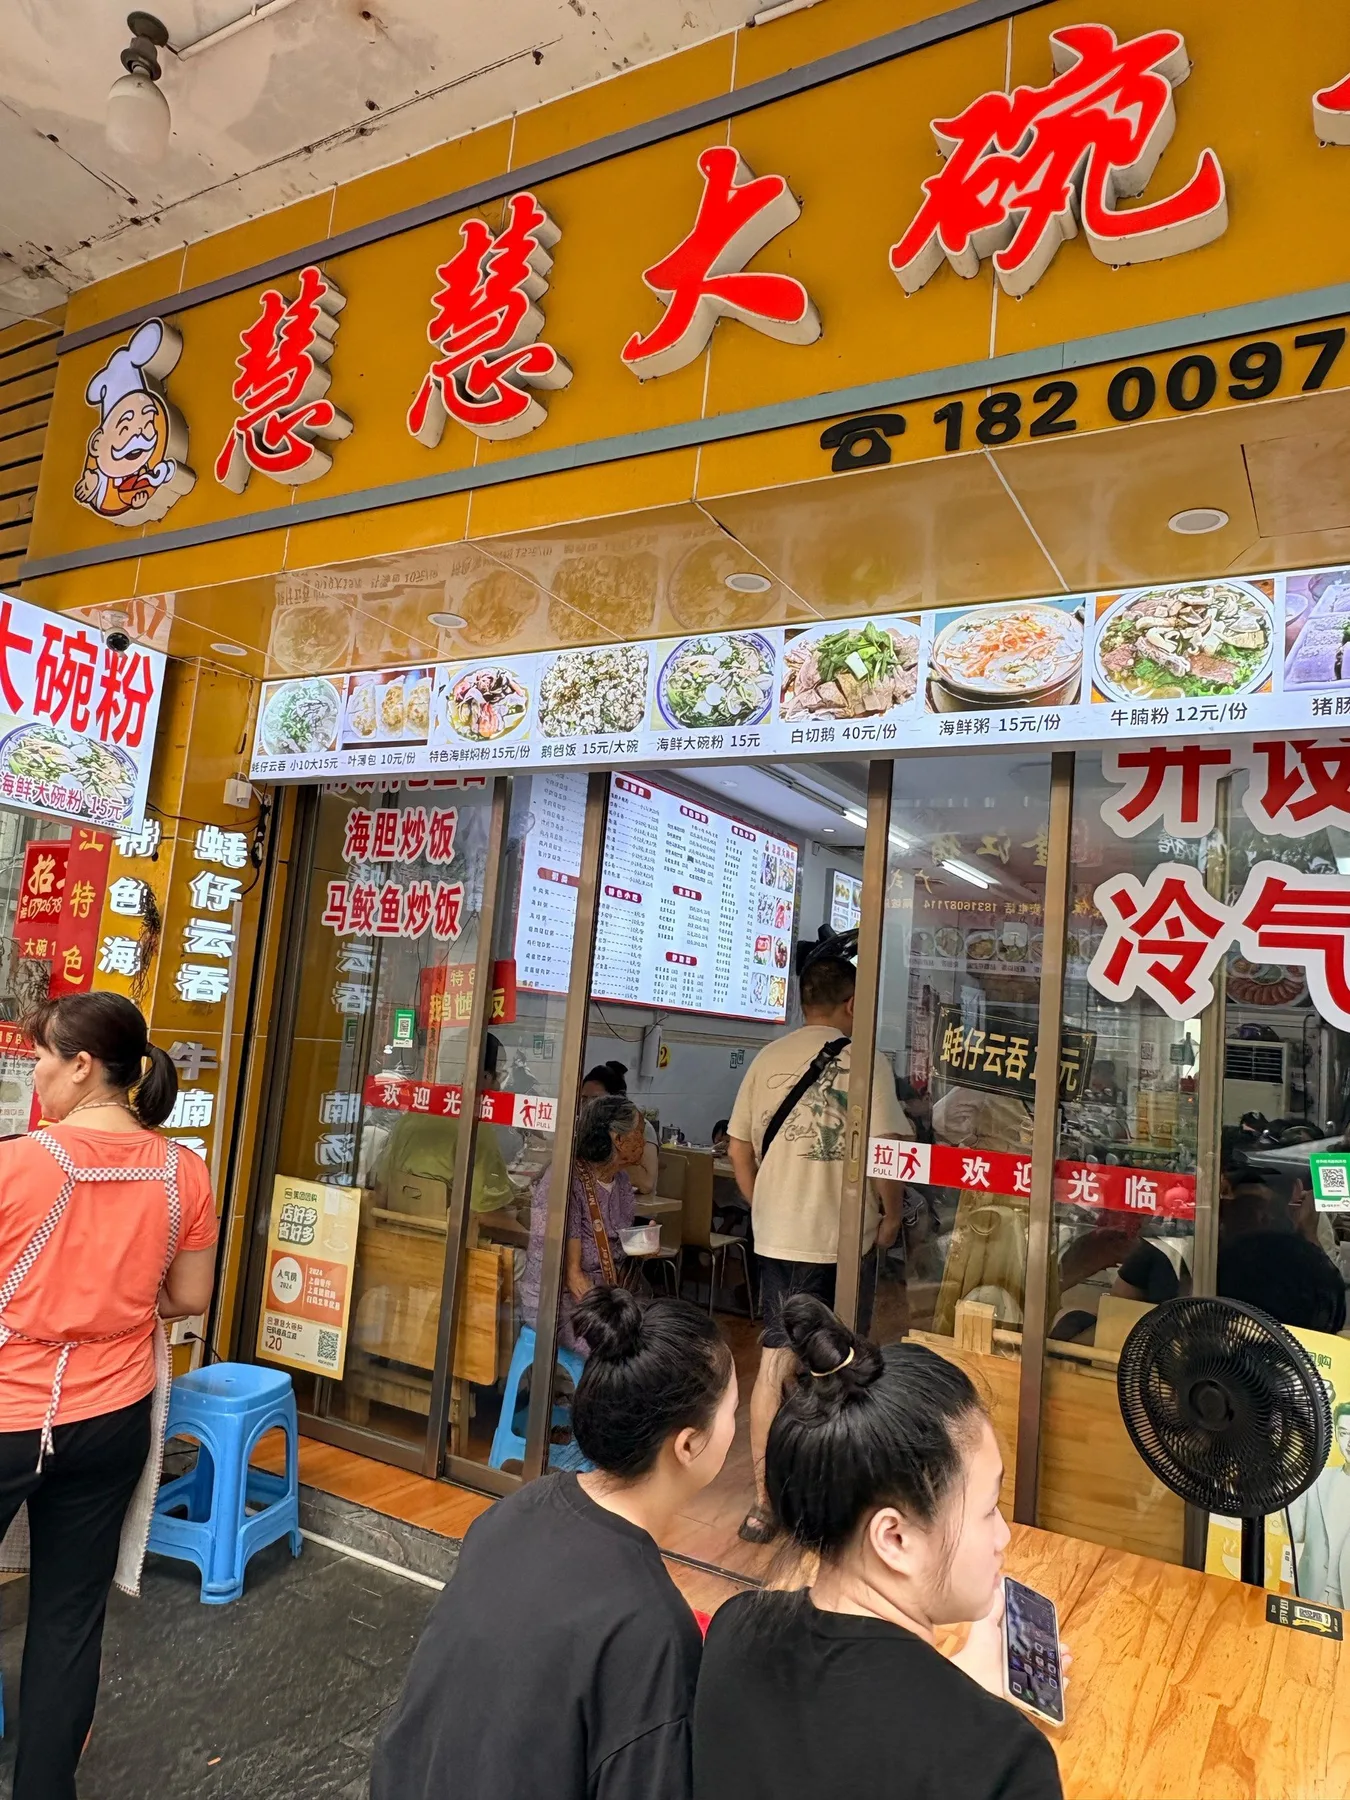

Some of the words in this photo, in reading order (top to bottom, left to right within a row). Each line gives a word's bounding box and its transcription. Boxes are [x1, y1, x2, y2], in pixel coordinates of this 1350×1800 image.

[215, 23, 1350, 483] 慧慧大碗
[933, 381, 1077, 451] 182
[1107, 328, 1346, 421] 0097
[0, 601, 154, 748] 大碗粉
[938, 718, 990, 736] 海鲜粥
[998, 714, 1061, 734] 15元/份
[1110, 707, 1168, 727] 牛腩粉
[1175, 702, 1248, 723] 12元/份
[656, 735, 724, 751] 海鲜大碗粉
[731, 733, 761, 748] 15元
[791, 727, 835, 743] 白切鹅
[842, 723, 897, 742] 40元/份
[429, 748, 490, 763] 特色海鲜焖粉
[492, 745, 530, 759] 15元/份
[582, 739, 639, 755] 15元/大碗
[251, 760, 286, 773] 蚝仔云吞
[290, 757, 339, 771] 小10大15元
[381, 752, 416, 766] 10元/份
[0, 771, 84, 814] 海鲜大碗粉
[90, 795, 124, 822] 15元
[345, 809, 457, 861] 海胆炒饭
[175, 823, 248, 1004] 蚝仔云吞
[324, 884, 463, 937] 马鲛鱼炒饭
[1103, 876, 1350, 1016] 冷气
[538, 1102, 553, 1121] 拉
[536, 1122, 551, 1130] PULL
[873, 1144, 894, 1166] 拉
[872, 1167, 893, 1178] PULL
[960, 1155, 1159, 1210] 欢迎光临
